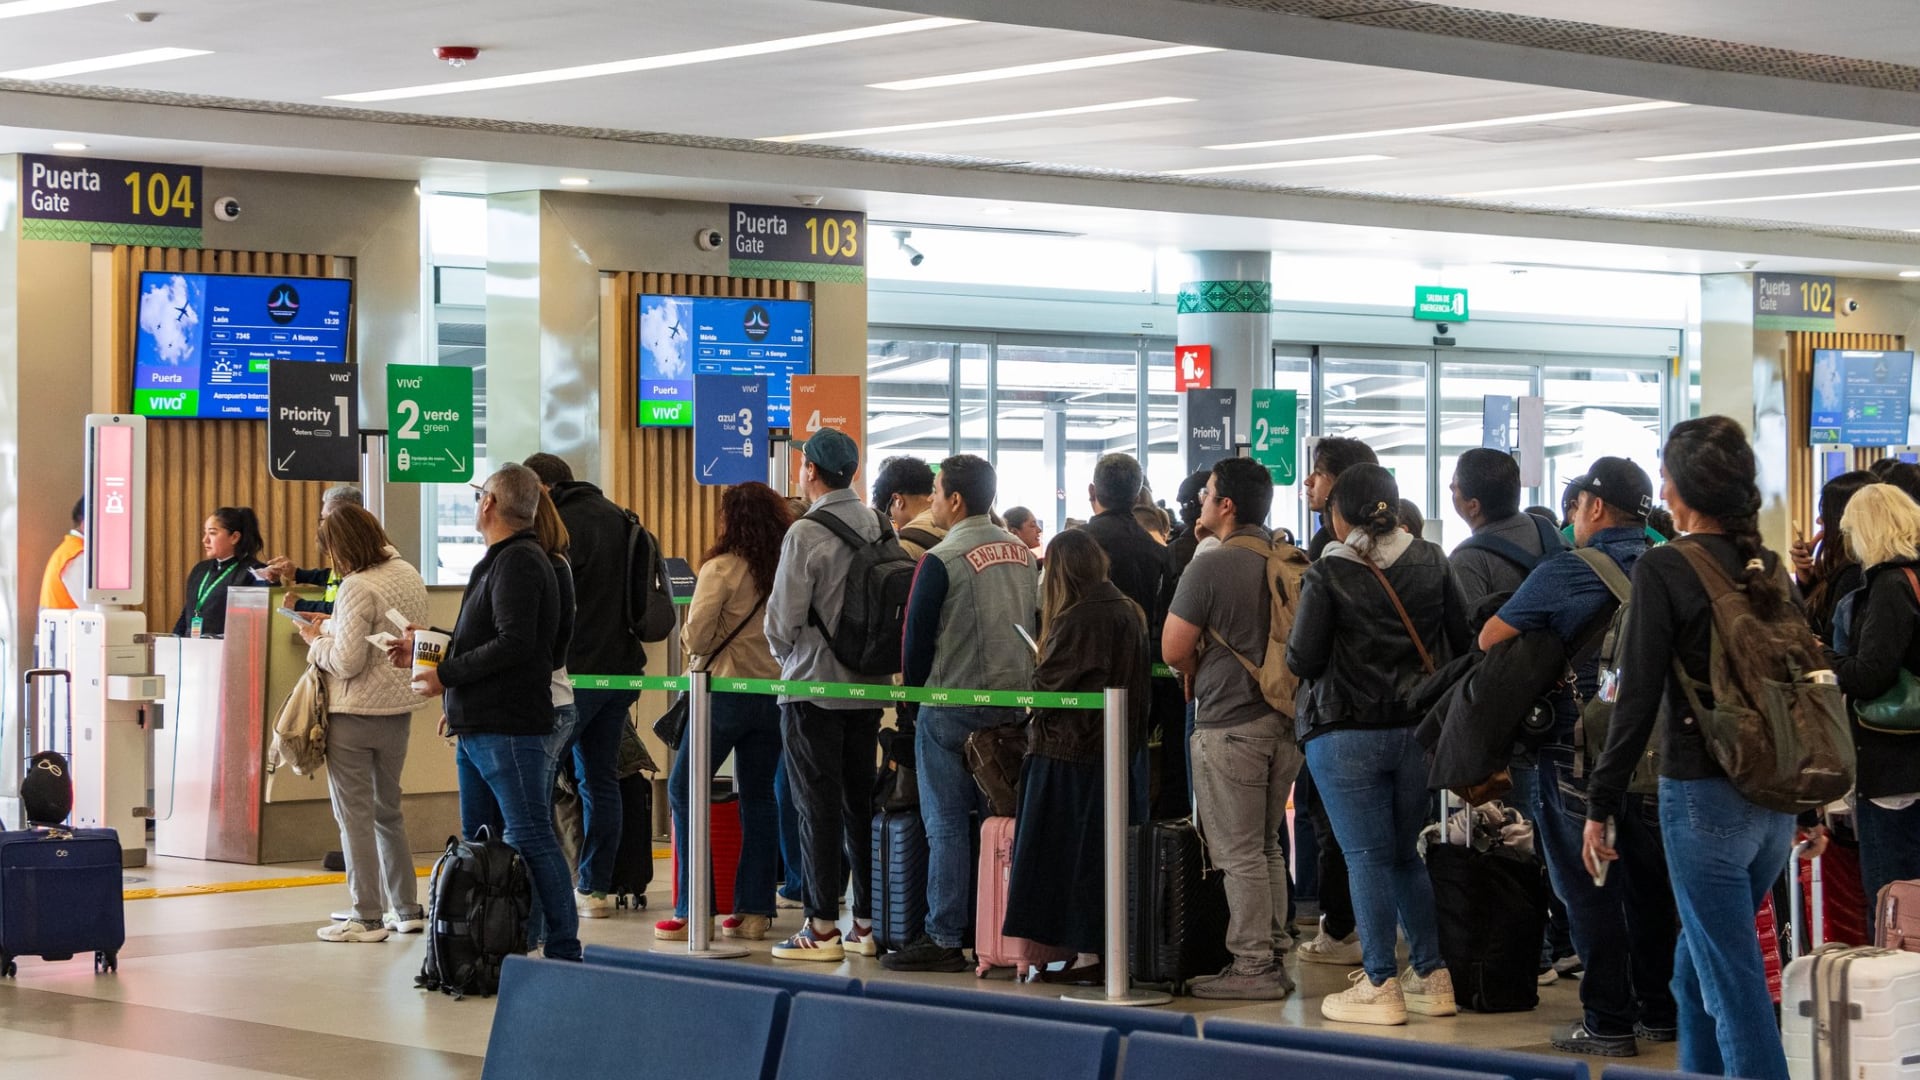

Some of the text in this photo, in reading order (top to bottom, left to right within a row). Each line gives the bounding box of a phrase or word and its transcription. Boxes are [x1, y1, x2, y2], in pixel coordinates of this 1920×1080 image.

[32, 162, 101, 191] Puerta
[31, 190, 70, 212] Gate
[124, 172, 195, 218] 104
[736, 211, 788, 235] Puerta
[736, 234, 764, 254] Gate
[805, 217, 857, 257] 103
[1760, 278, 1791, 296] Puerta
[1800, 282, 1832, 312] 102
[1760, 296, 1777, 310] Gate
[152, 373, 183, 383] Puerta
[653, 385, 678, 395] Puerta
[280, 406, 331, 426] Priority
[335, 396, 349, 437] 1
[397, 399, 420, 440] 2
[423, 409, 460, 421] verde
[717, 413, 736, 422] azul
[738, 408, 753, 436] 3
[805, 409, 822, 432] 4
[822, 416, 847, 425] naranja
[423, 424, 449, 435] green
[1193, 426, 1221, 441] Priority
[1222, 416, 1231, 450] 1
[1256, 418, 1269, 451] 2
[1270, 424, 1290, 435] verde
[1500, 423, 1506, 448] 3
[969, 544, 1027, 568] ENGLAND
[417, 641, 441, 654] COLD
